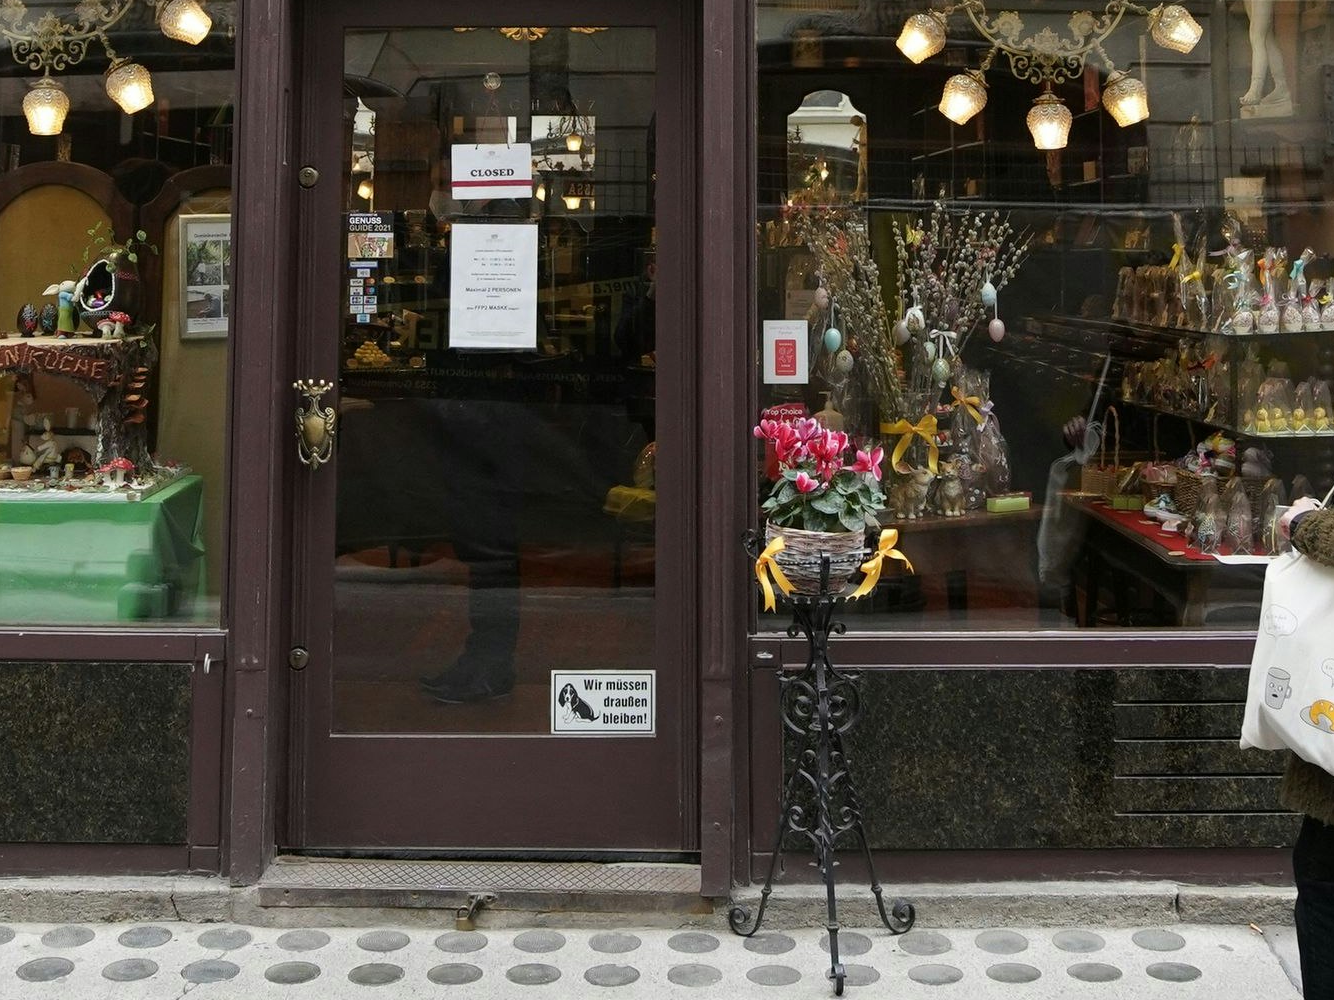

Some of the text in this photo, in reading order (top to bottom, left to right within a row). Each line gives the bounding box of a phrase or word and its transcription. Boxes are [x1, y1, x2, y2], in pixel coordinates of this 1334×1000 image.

[470, 168, 515, 177] CLOSED
[349, 216, 382, 225] GENUSS
[780, 407, 803, 416] Choice
[583, 679, 648, 691] Wir müssen
[603, 695, 648, 708] draußen
[602, 712, 648, 724] bleiben!
